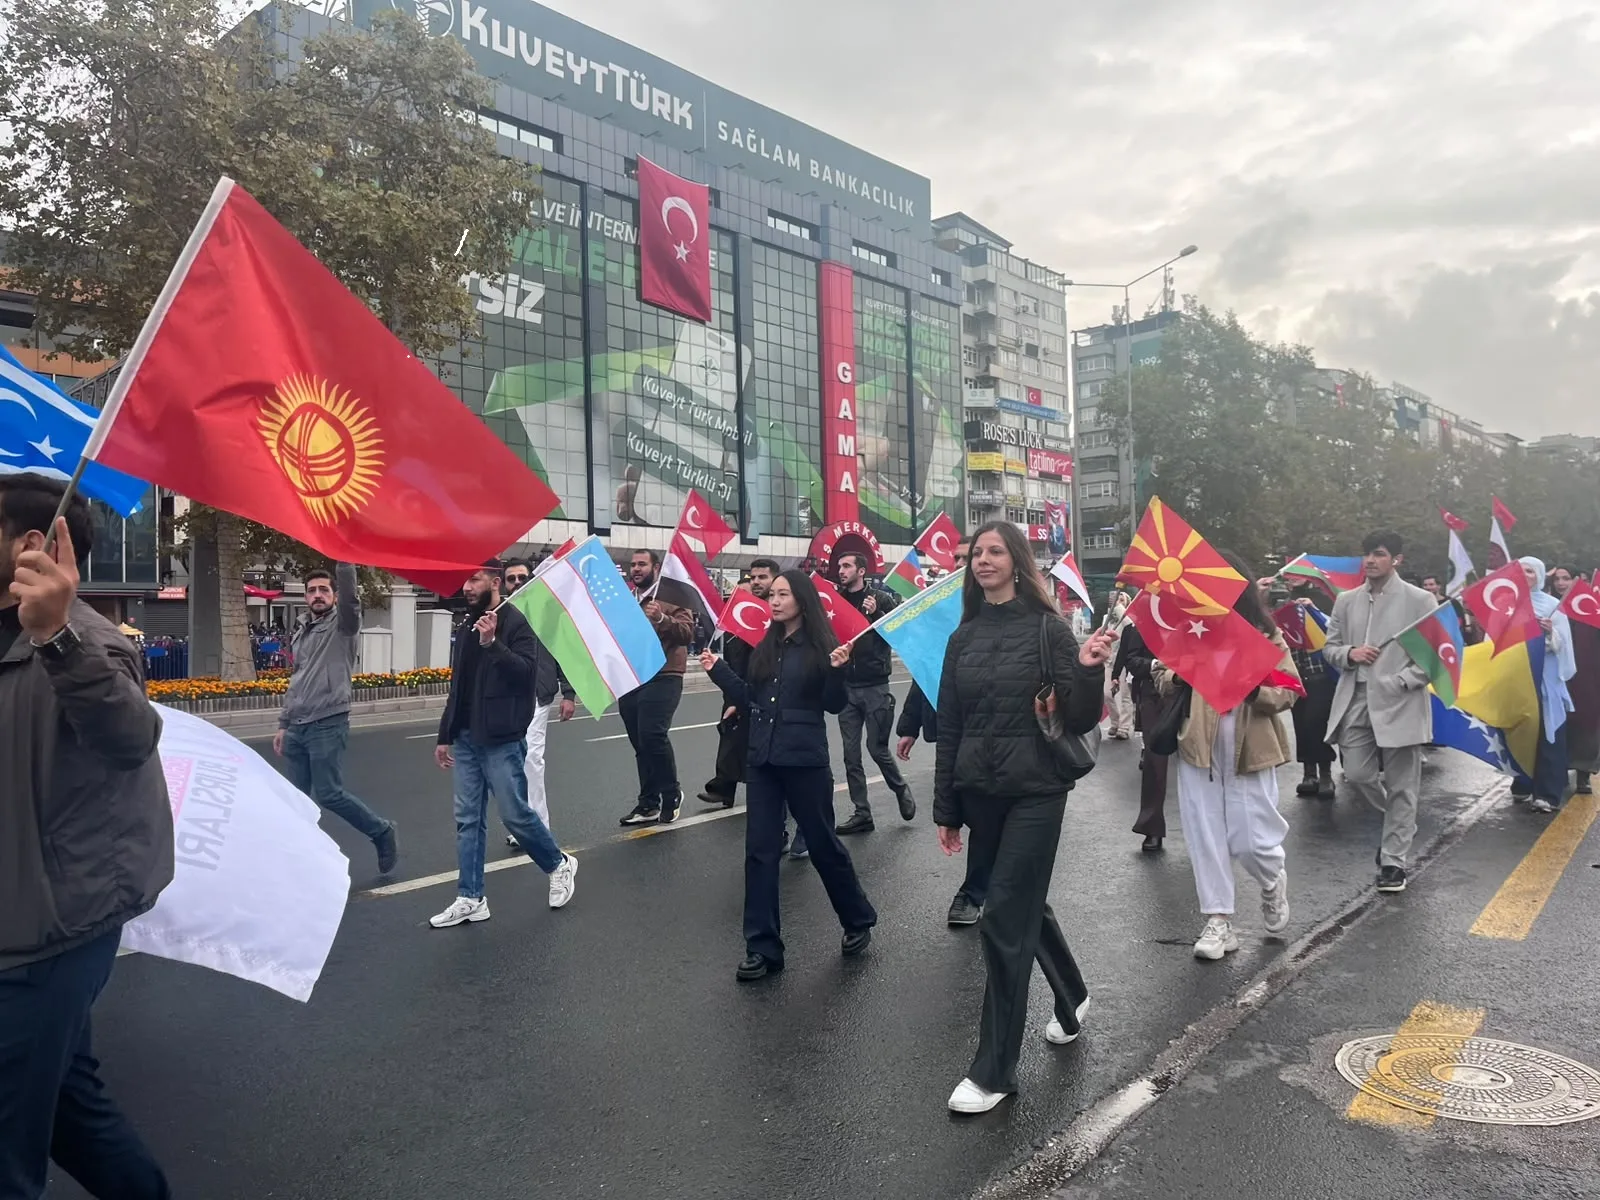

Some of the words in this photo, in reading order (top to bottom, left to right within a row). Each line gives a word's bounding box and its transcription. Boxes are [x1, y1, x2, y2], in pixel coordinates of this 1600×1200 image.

[718, 120, 800, 171] SAĞLAM
[809, 159, 914, 217] BANKACILIK
[569, 203, 639, 245] İNTERN
[643, 375, 685, 409] Kuveyt
[837, 361, 856, 493] GAMA
[1019, 429, 1042, 449] LUCK
[627, 432, 673, 469] Kuveyt
[677, 458, 716, 492] Türklü
